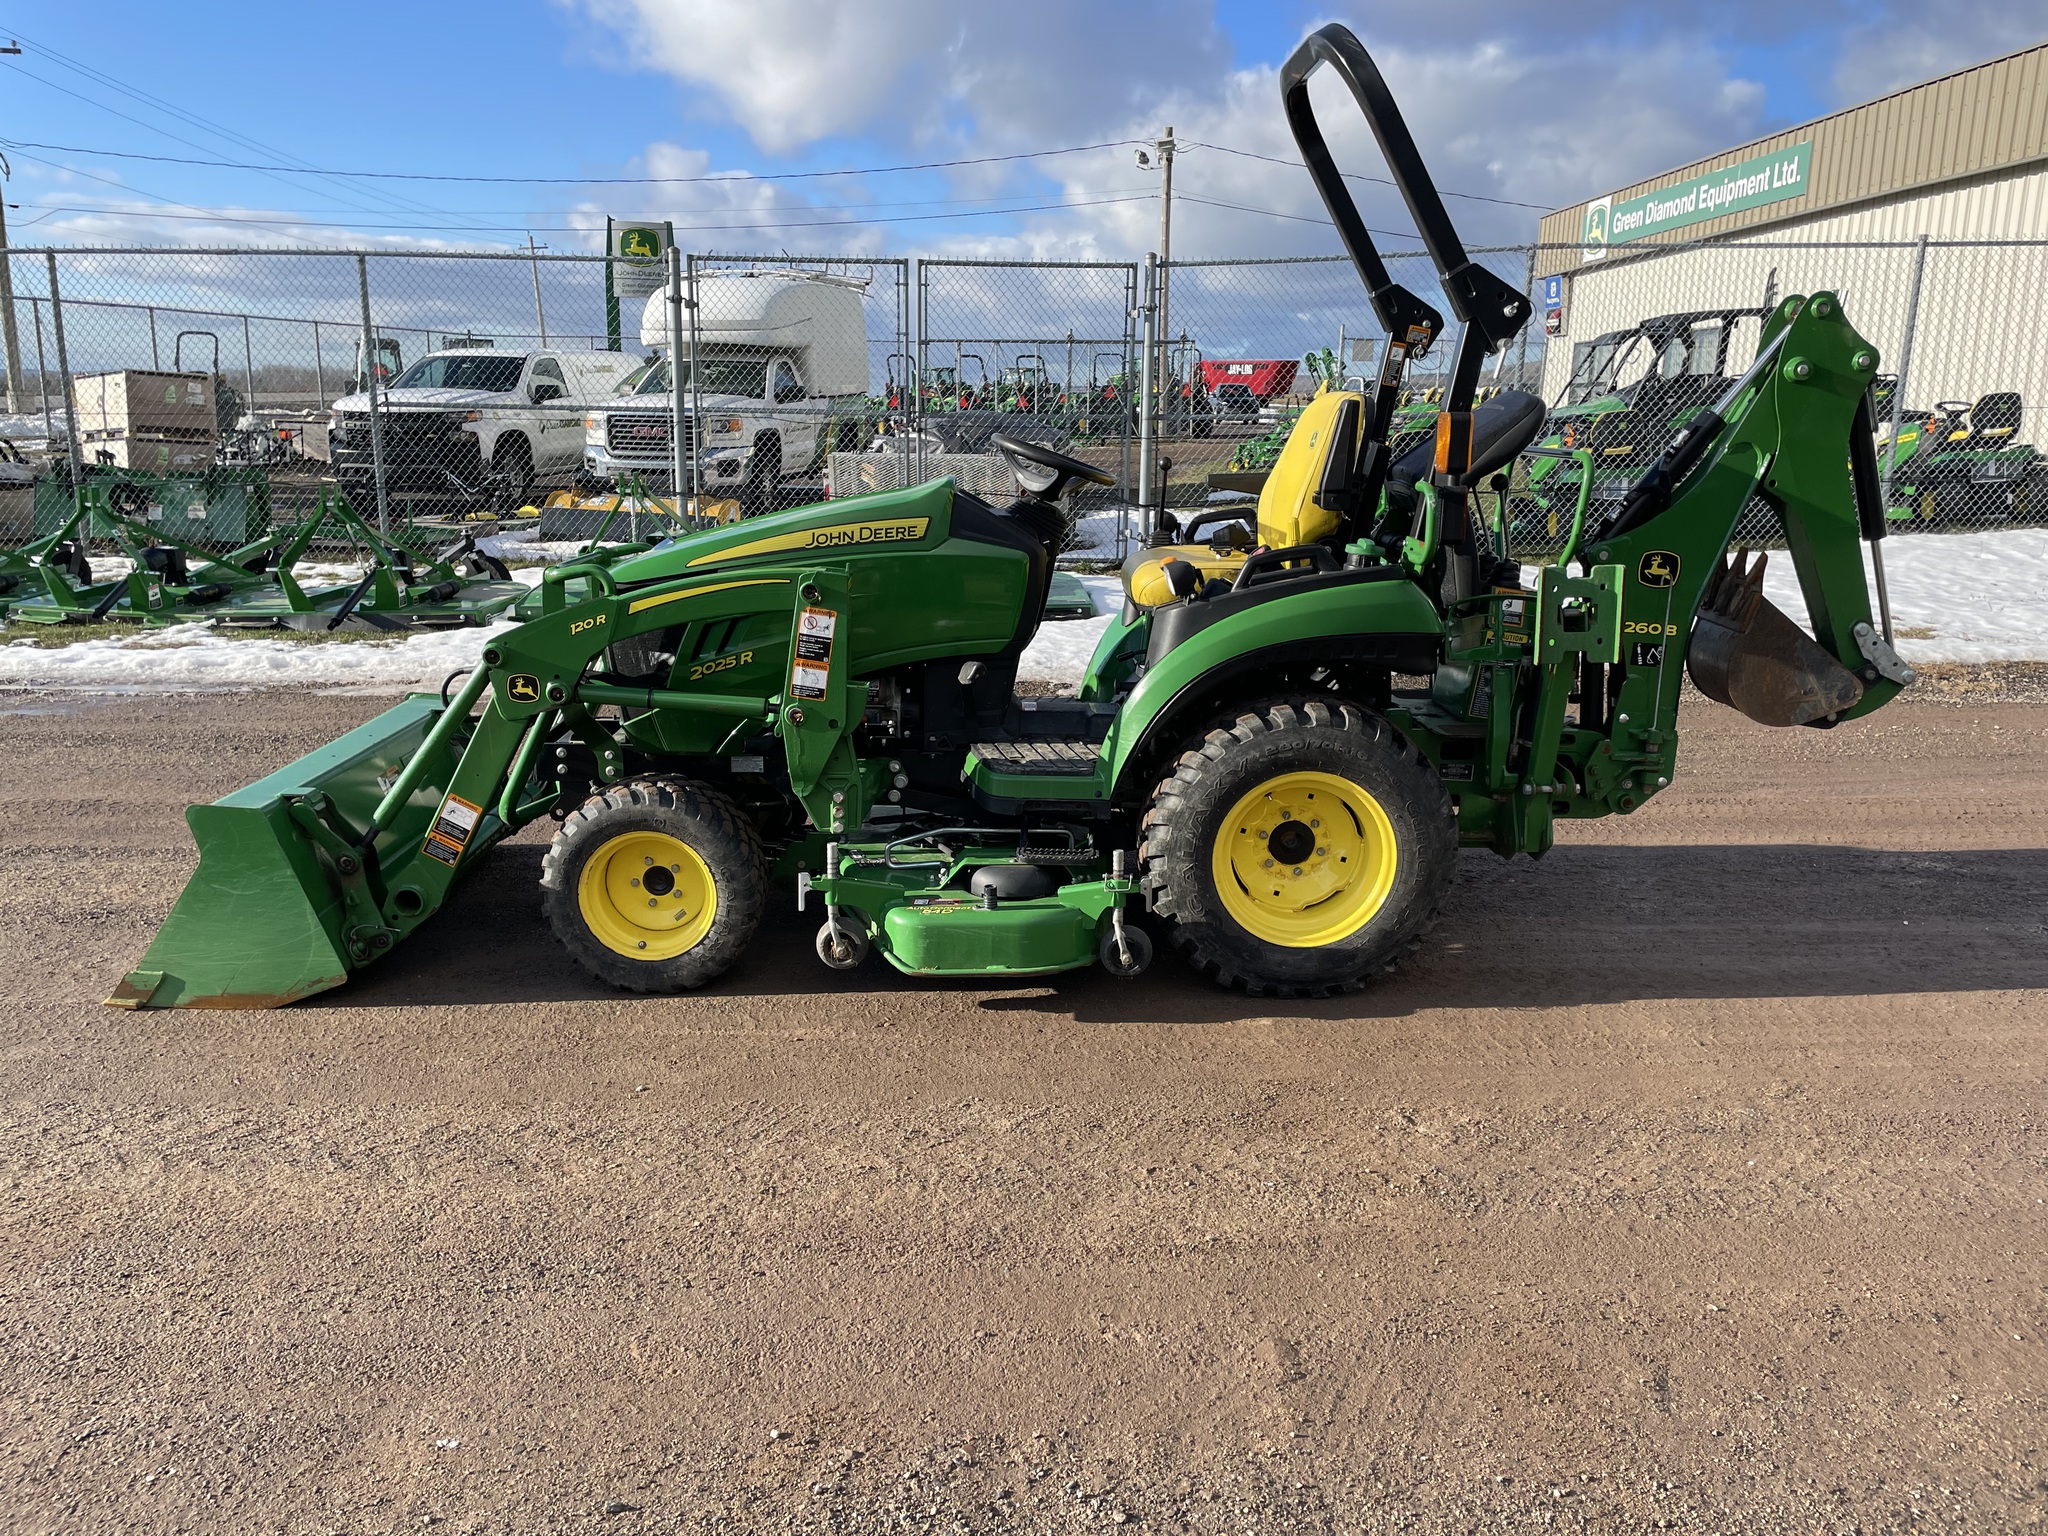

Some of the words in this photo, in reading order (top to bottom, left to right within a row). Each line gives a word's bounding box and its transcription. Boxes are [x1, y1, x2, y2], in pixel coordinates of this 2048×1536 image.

[1612, 210, 1643, 235] Green
[1645, 187, 1697, 224] Diamond
[1698, 166, 1771, 213] Equipment
[1773, 155, 1802, 189] Ltd.
[638, 270, 664, 278] DEERE
[633, 427, 669, 437] GMC
[805, 530, 855, 547] JOHN
[859, 525, 918, 541] DEERE
[808, 608, 835, 618] WARNING
[570, 618, 594, 636] 120
[596, 613, 607, 626] R
[1623, 620, 1663, 635] 260
[1665, 623, 1678, 637] B
[689, 656, 737, 682] 2025
[740, 651, 753, 666] R
[801, 661, 828, 671] WARNING
[1182, 757, 1248, 917] GALAXY
